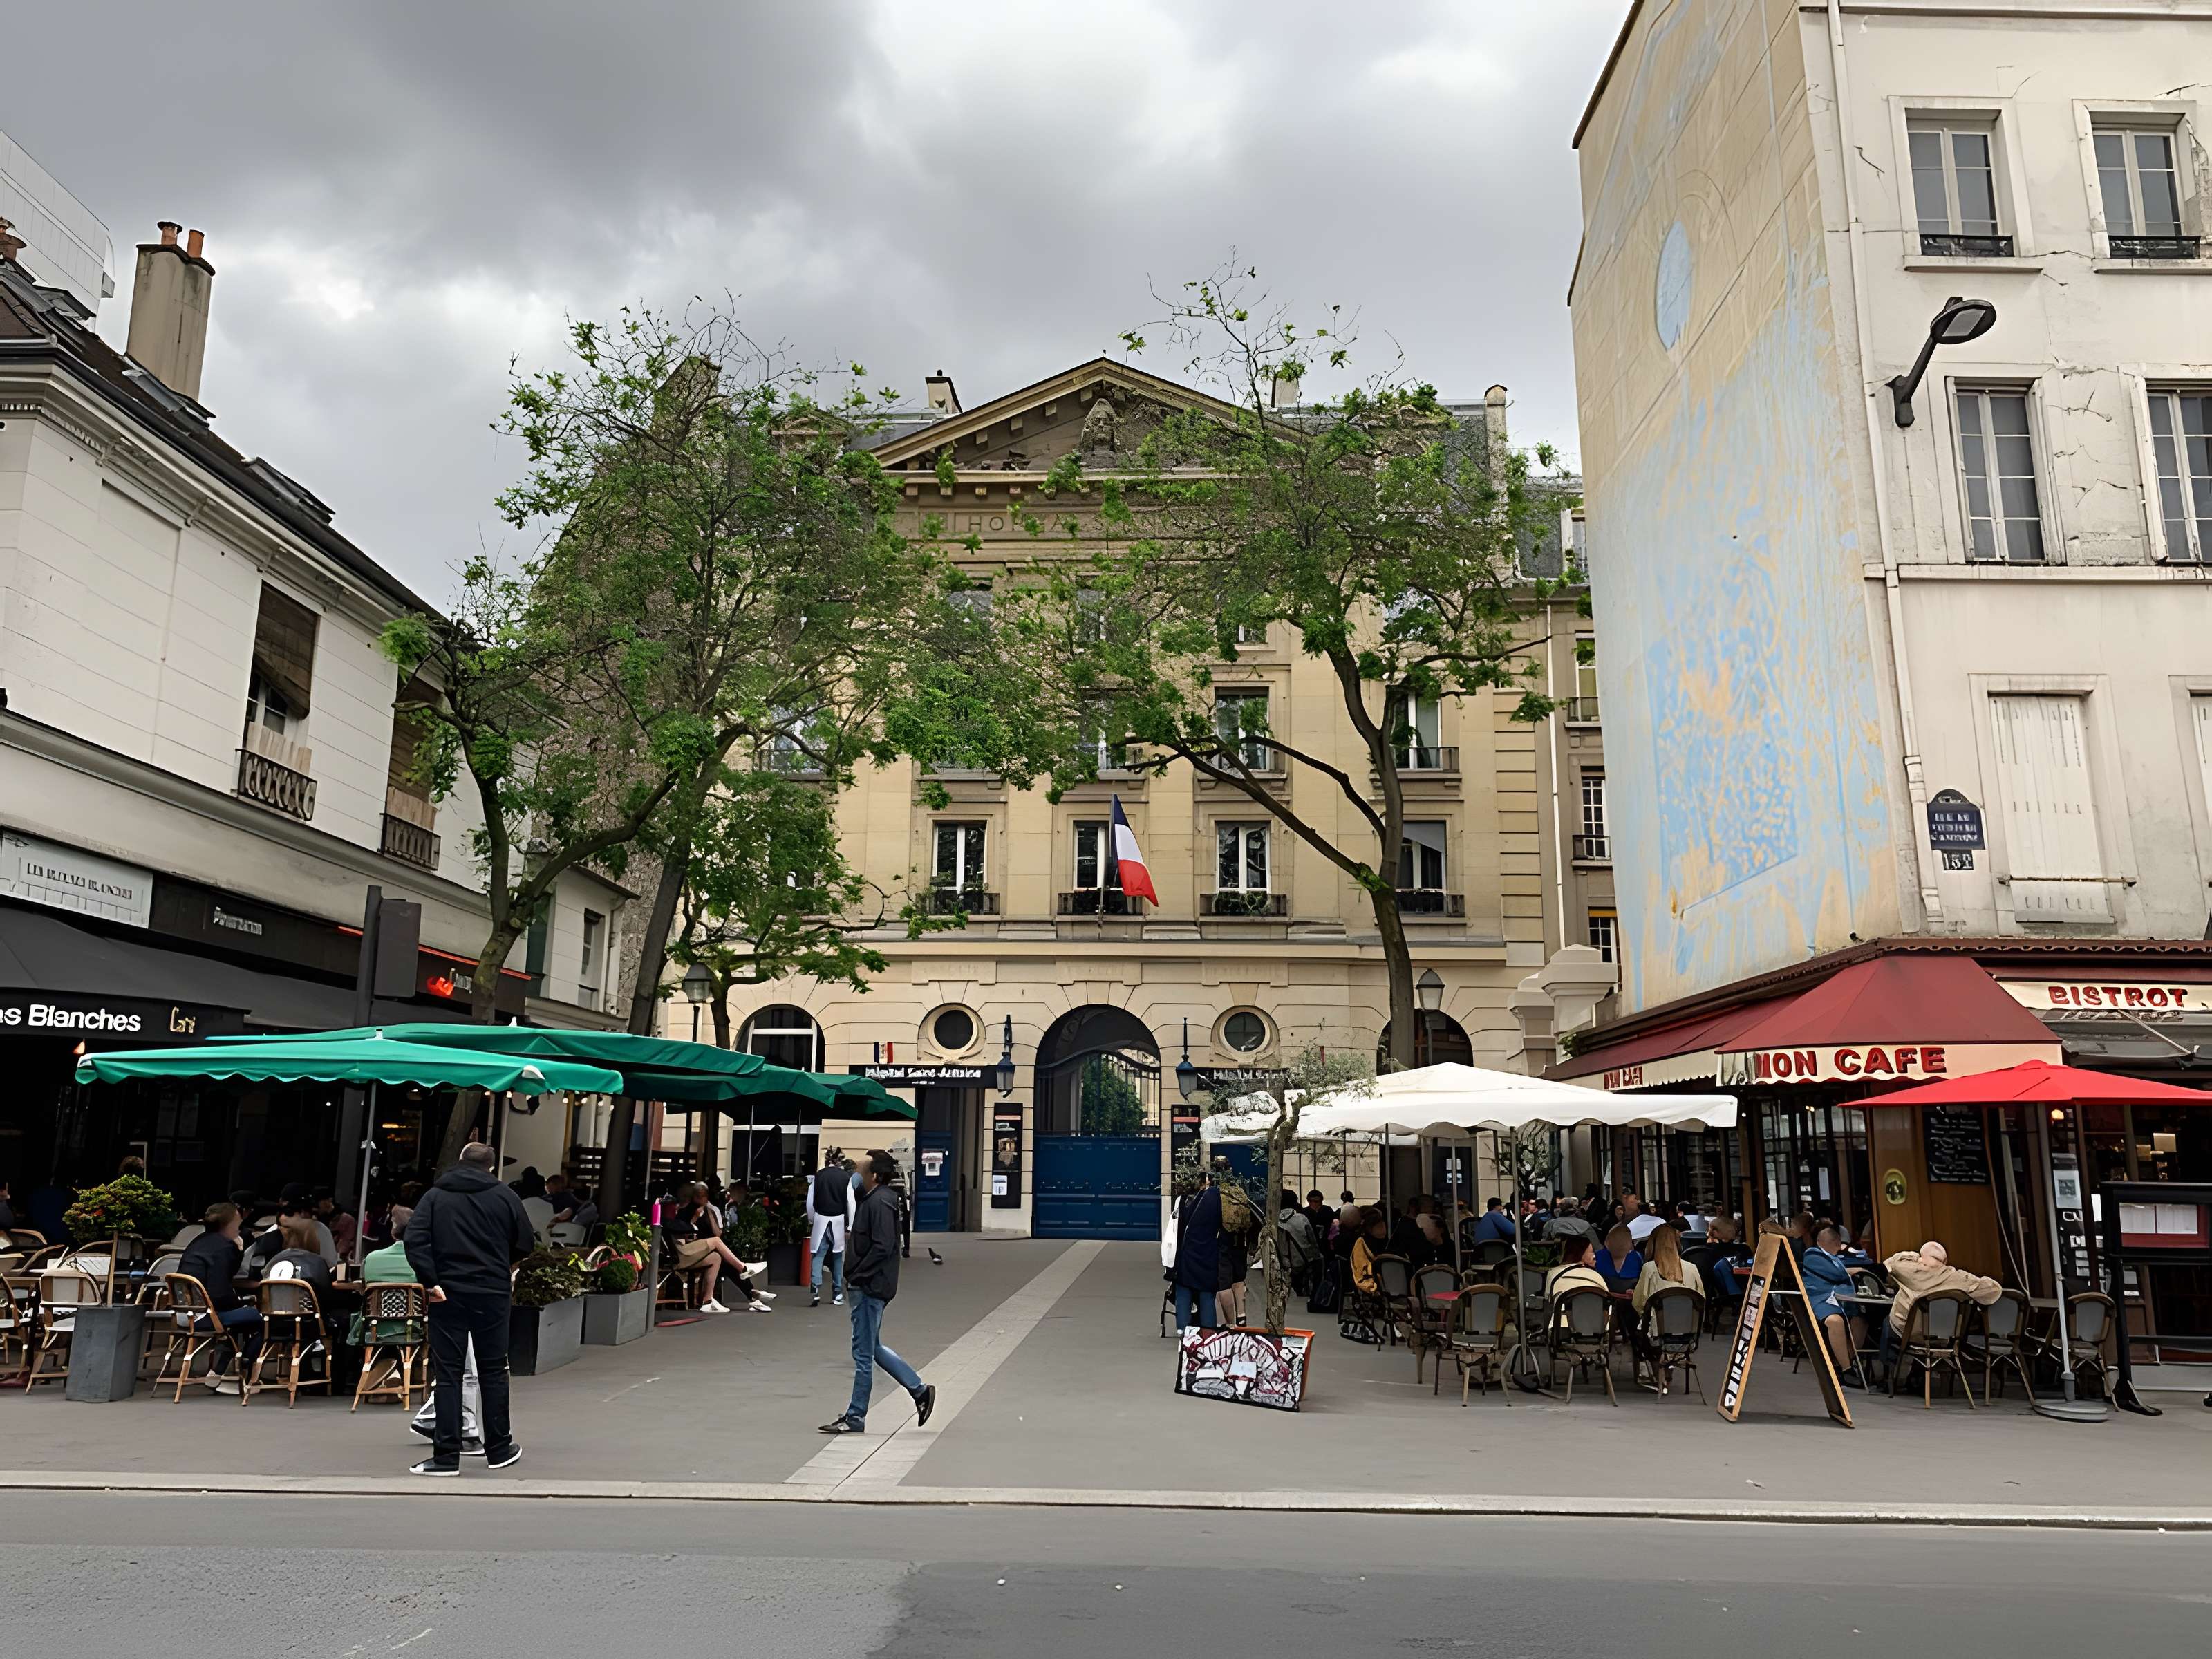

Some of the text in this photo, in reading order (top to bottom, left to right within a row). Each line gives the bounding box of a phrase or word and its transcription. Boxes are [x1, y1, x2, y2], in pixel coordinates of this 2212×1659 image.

[2047, 986, 2188, 1007] BISTROT
[28, 1004, 142, 1032] Blanches
[1833, 1047, 1948, 1076] CAFE
